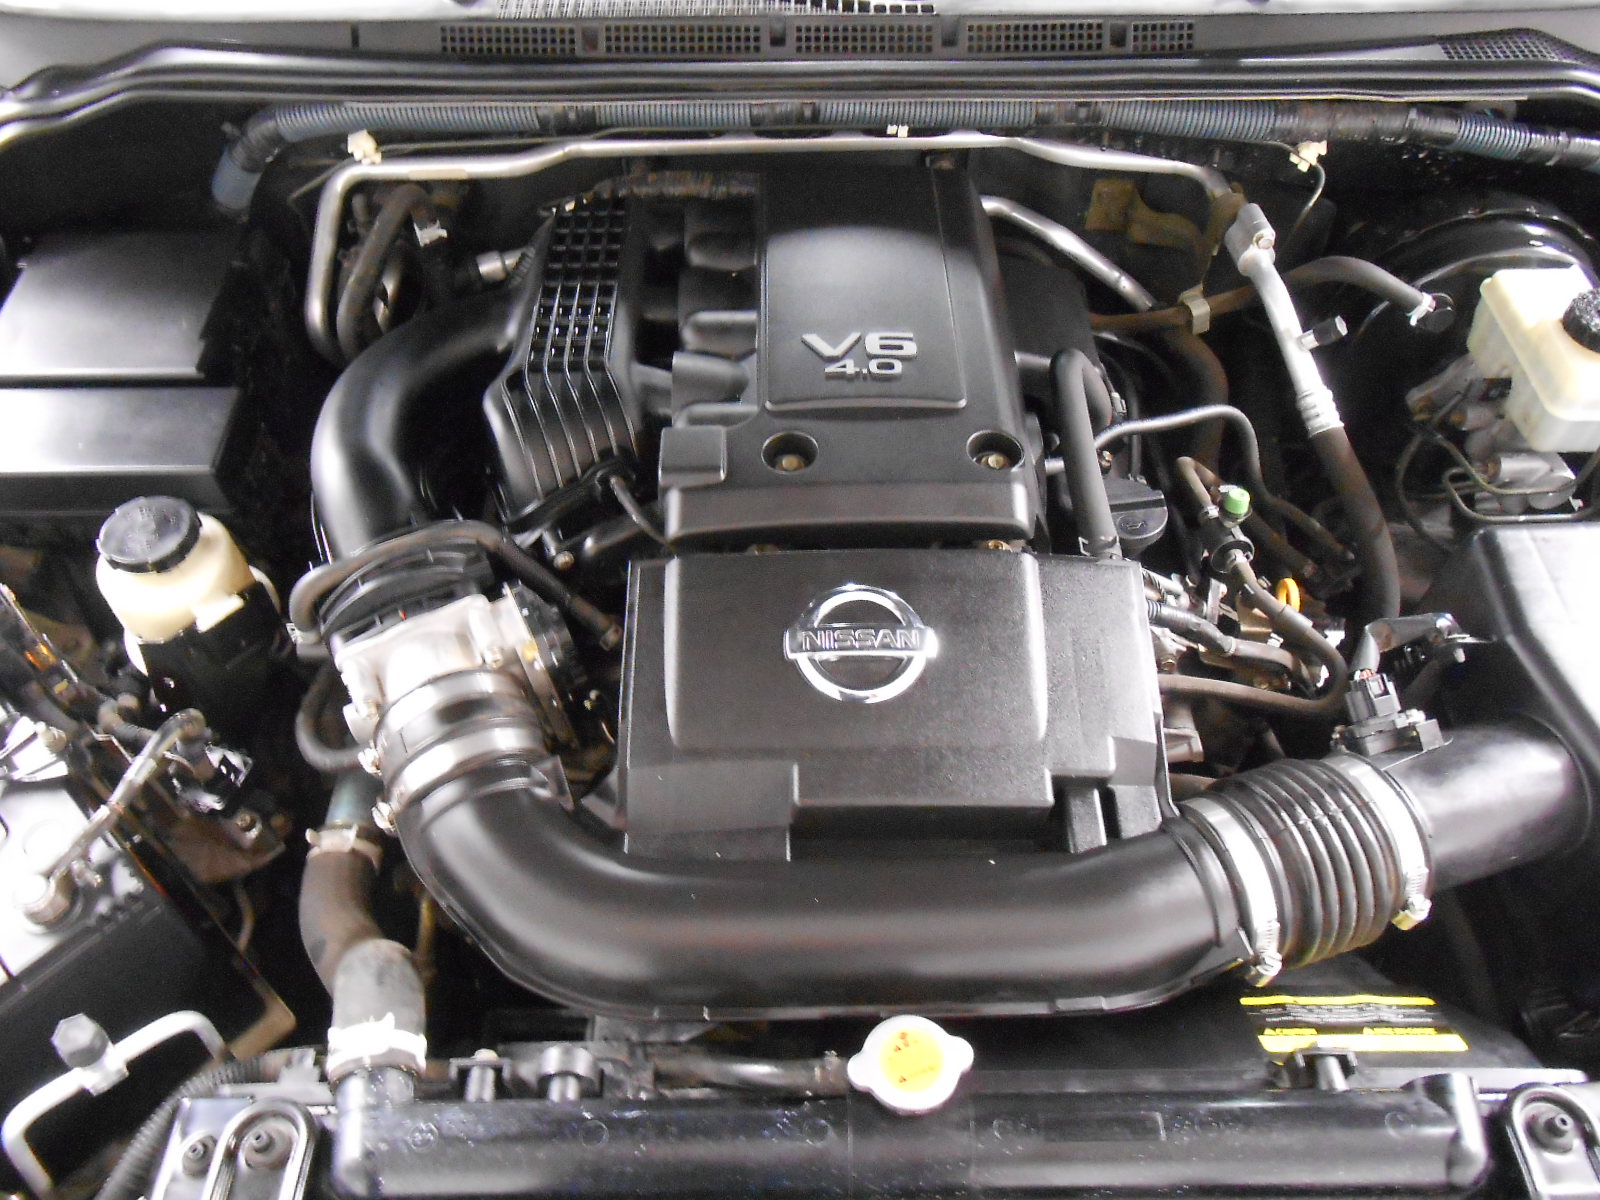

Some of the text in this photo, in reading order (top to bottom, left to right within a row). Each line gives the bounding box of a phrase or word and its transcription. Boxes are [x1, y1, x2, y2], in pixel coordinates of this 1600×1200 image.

[801, 332, 917, 361] V6
[824, 358, 902, 380] 4.0
[801, 629, 920, 650] NISSAN
